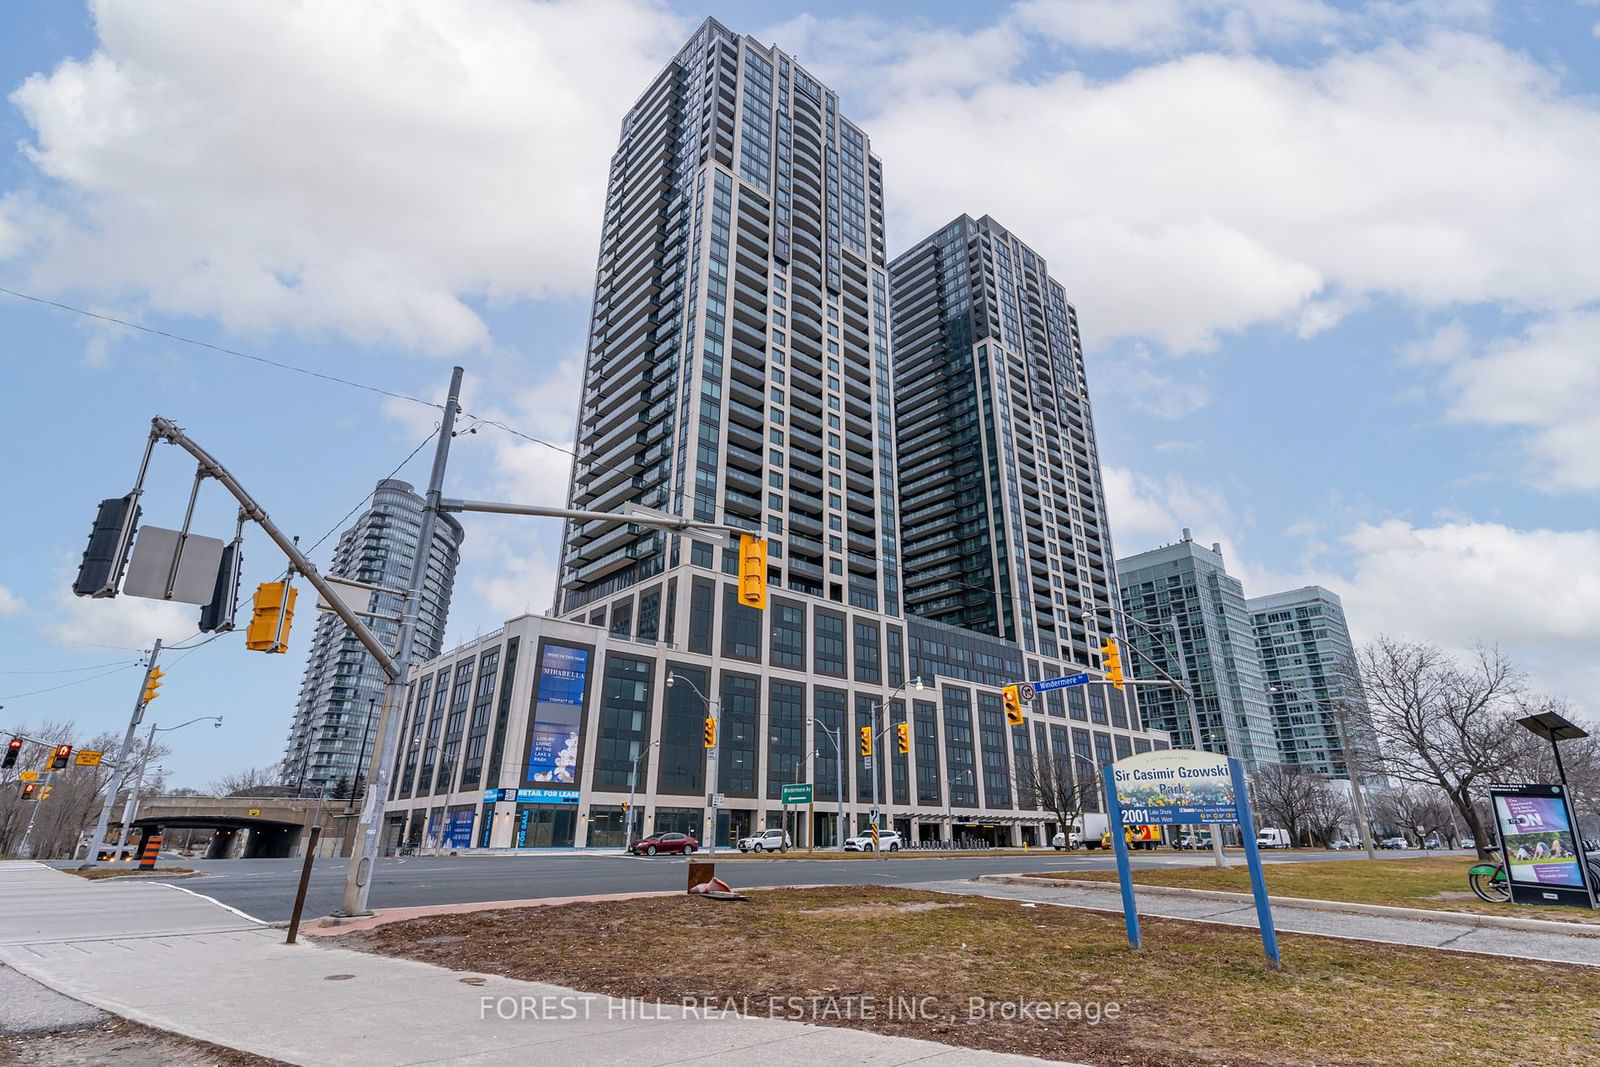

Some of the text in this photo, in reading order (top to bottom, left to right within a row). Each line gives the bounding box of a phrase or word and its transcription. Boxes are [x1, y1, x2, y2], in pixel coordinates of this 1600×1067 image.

[544, 667, 585, 679] MIRABELLA
[1040, 677, 1077, 689] Windermere
[1115, 764, 1229, 781] Sir Casimir Gzowski
[518, 789, 543, 797] RETAIL
[559, 790, 580, 798] LEASE
[1159, 783, 1186, 794] Park
[521, 809, 529, 830] SALE
[1121, 809, 1149, 823] 2001
